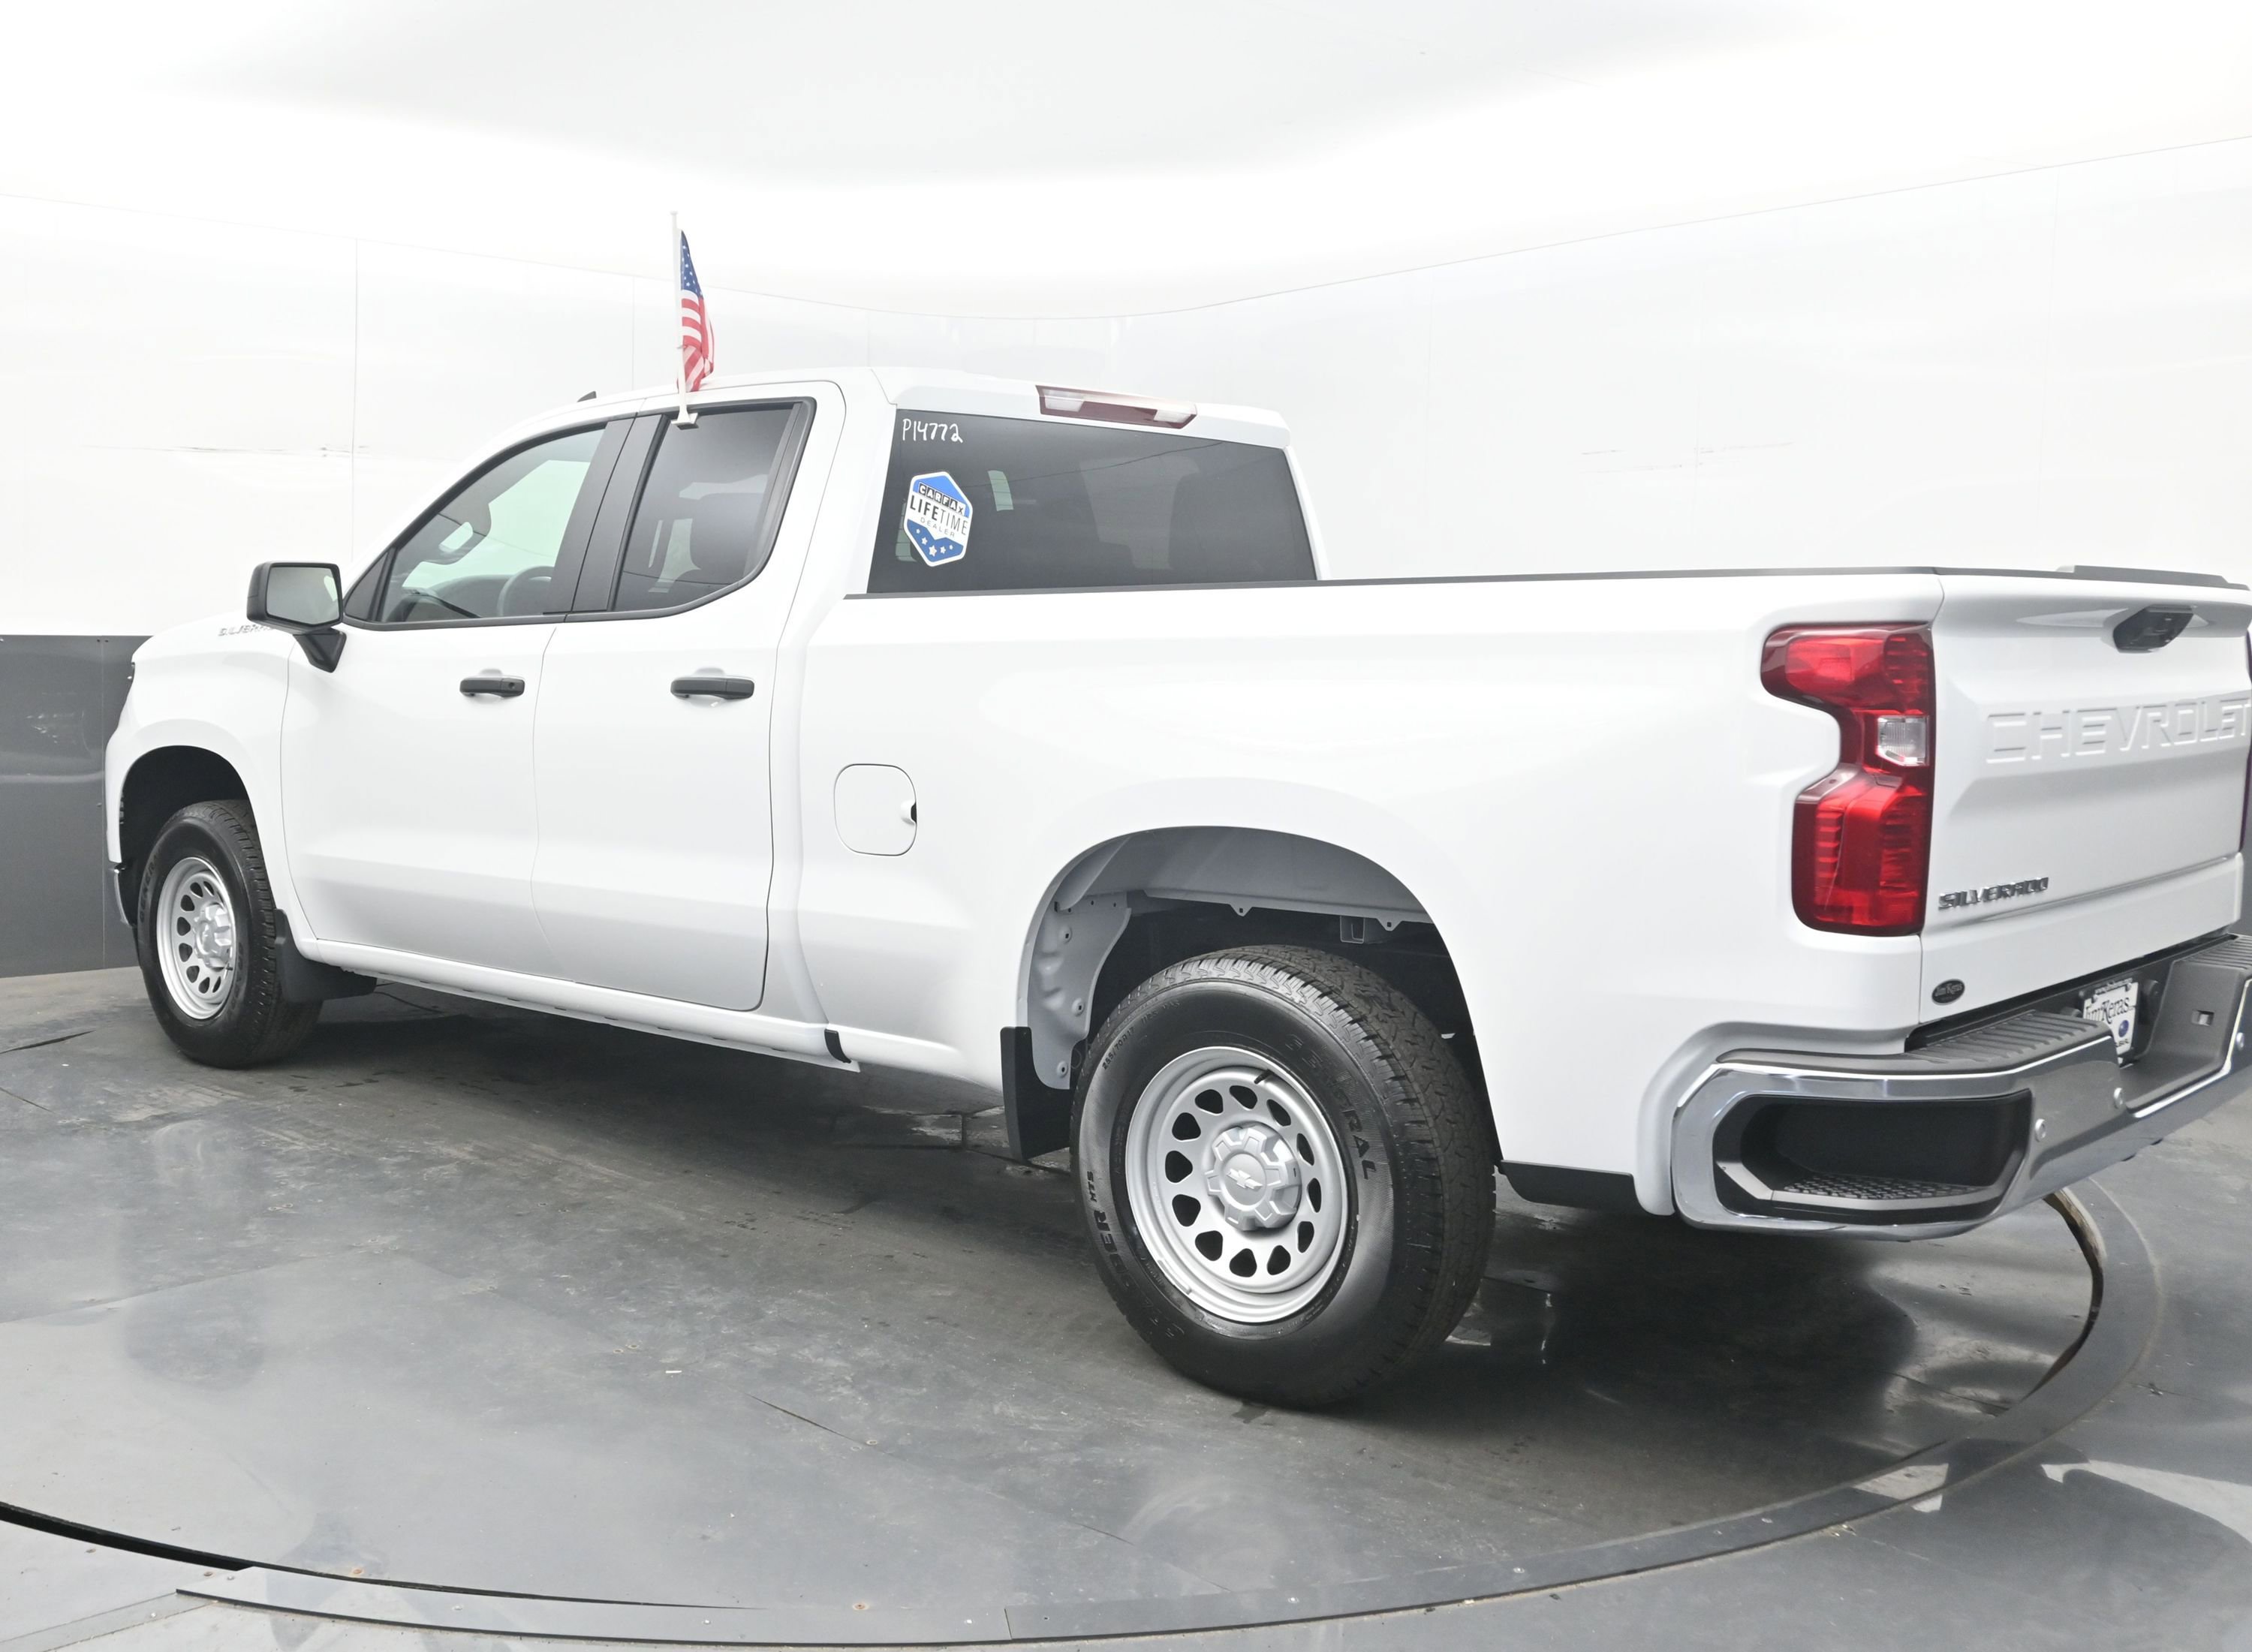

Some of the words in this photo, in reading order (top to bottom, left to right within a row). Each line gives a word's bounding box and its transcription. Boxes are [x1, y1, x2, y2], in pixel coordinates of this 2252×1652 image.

[902, 418, 963, 443] P14772
[918, 482, 966, 515] CARFAX
[910, 495, 968, 536] LIFETIME
[920, 516, 956, 537] DEALER
[1986, 697, 2251, 764] CHEVROLET
[1938, 877, 2049, 910] SILVERADO
